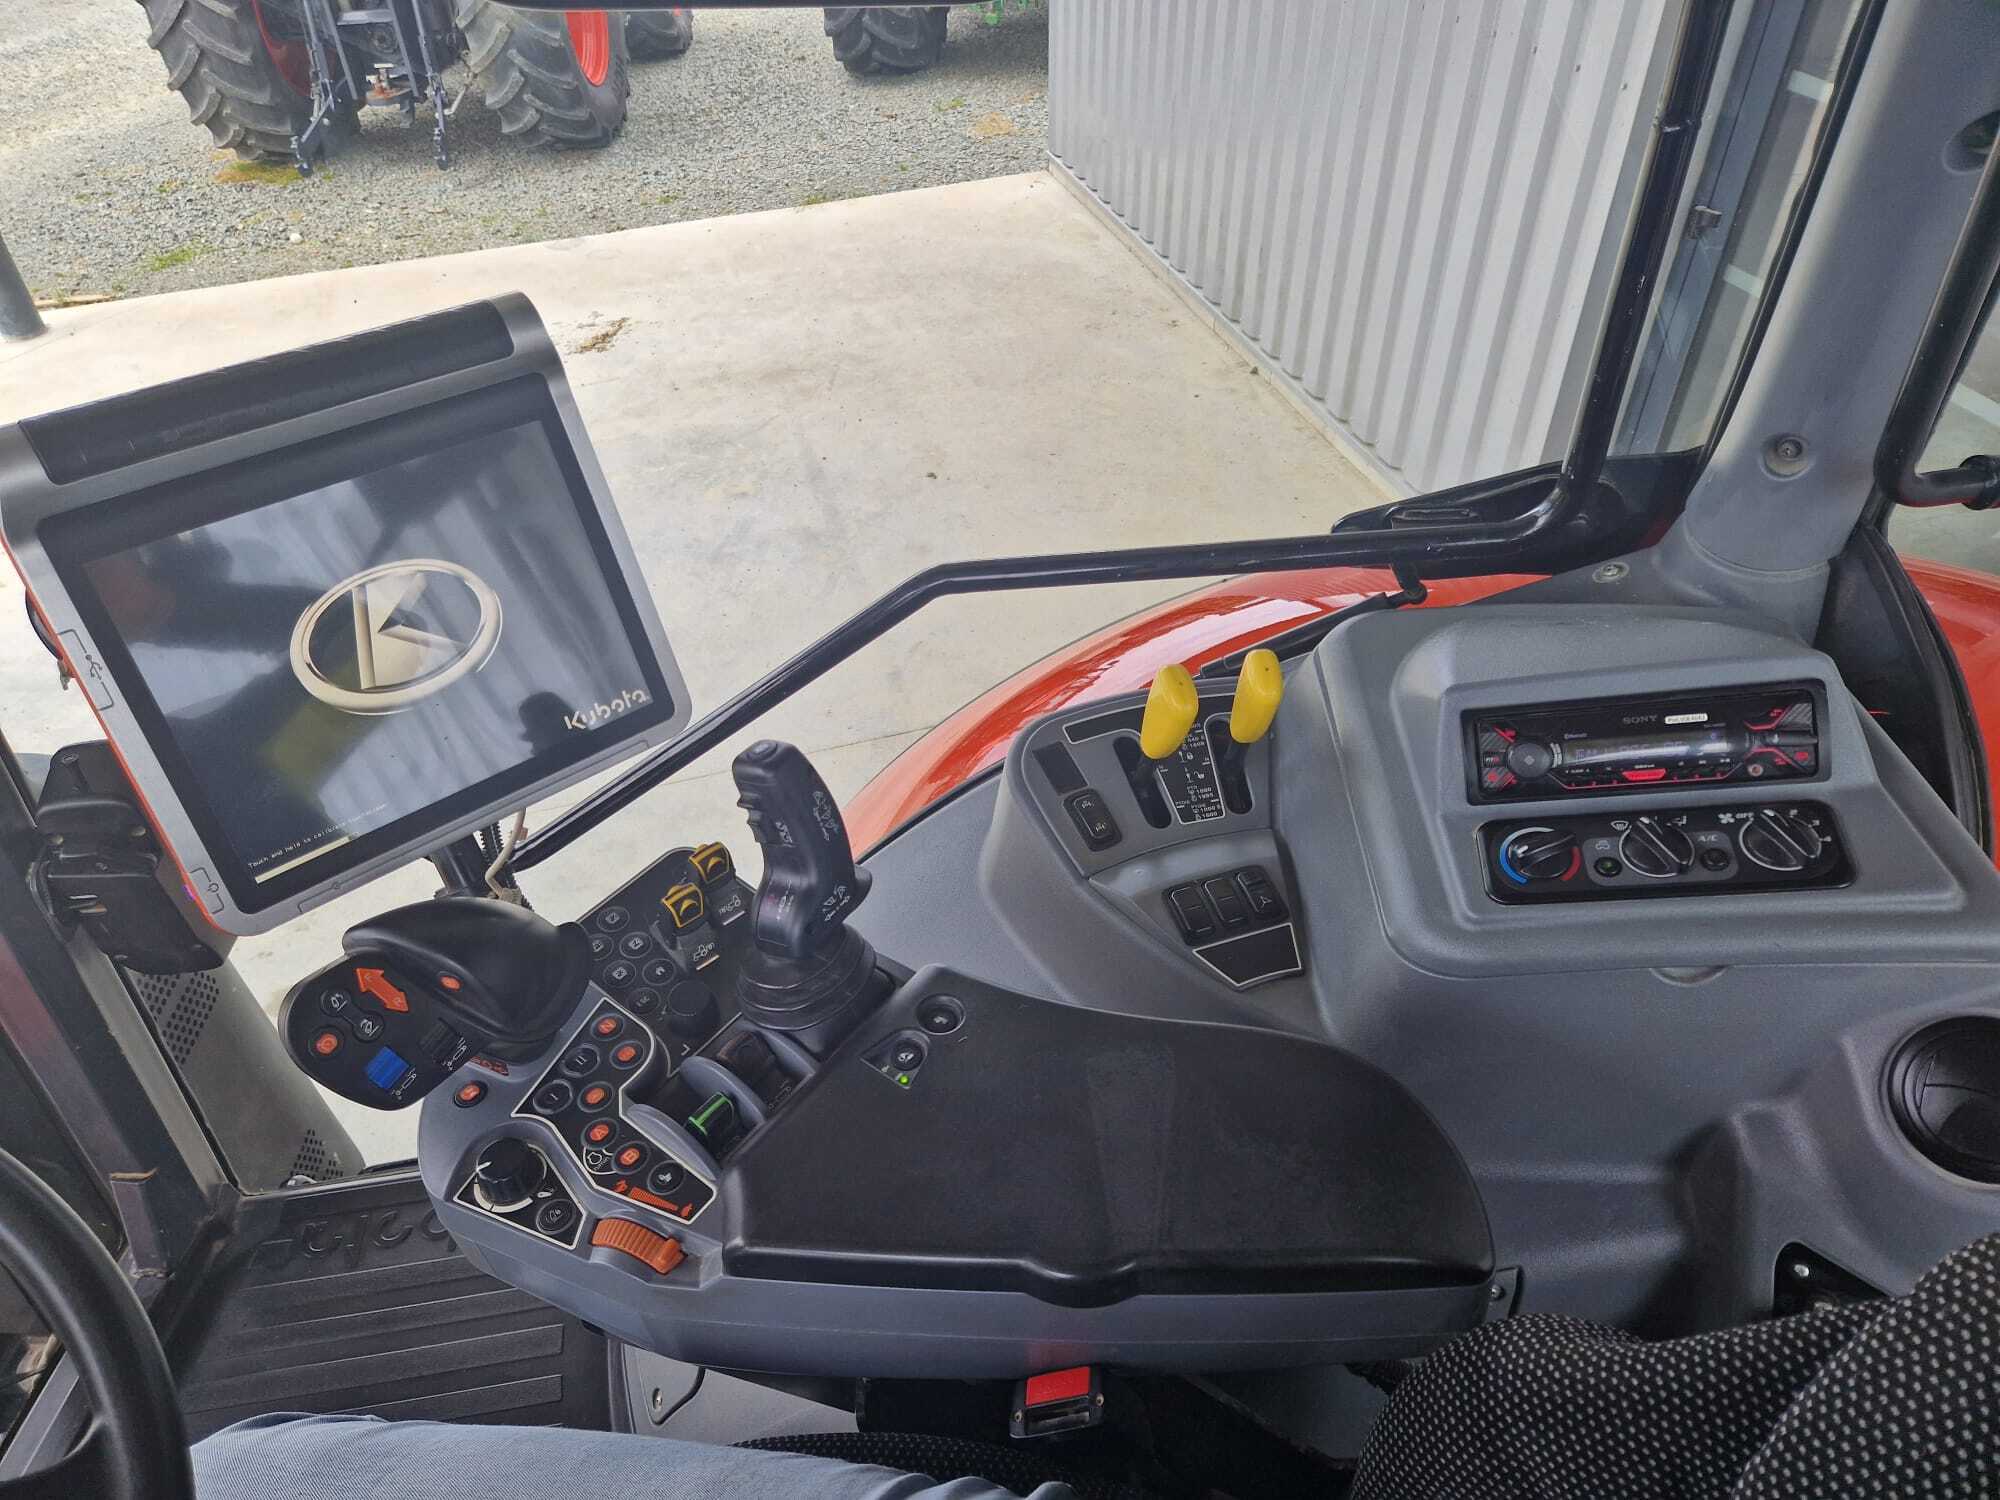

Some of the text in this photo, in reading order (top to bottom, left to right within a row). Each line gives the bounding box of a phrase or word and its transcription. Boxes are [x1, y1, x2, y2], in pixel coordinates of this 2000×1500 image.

[563, 690, 647, 730] Kubota
[1622, 714, 1658, 724] SONY
[1697, 834, 1719, 842] A/C
